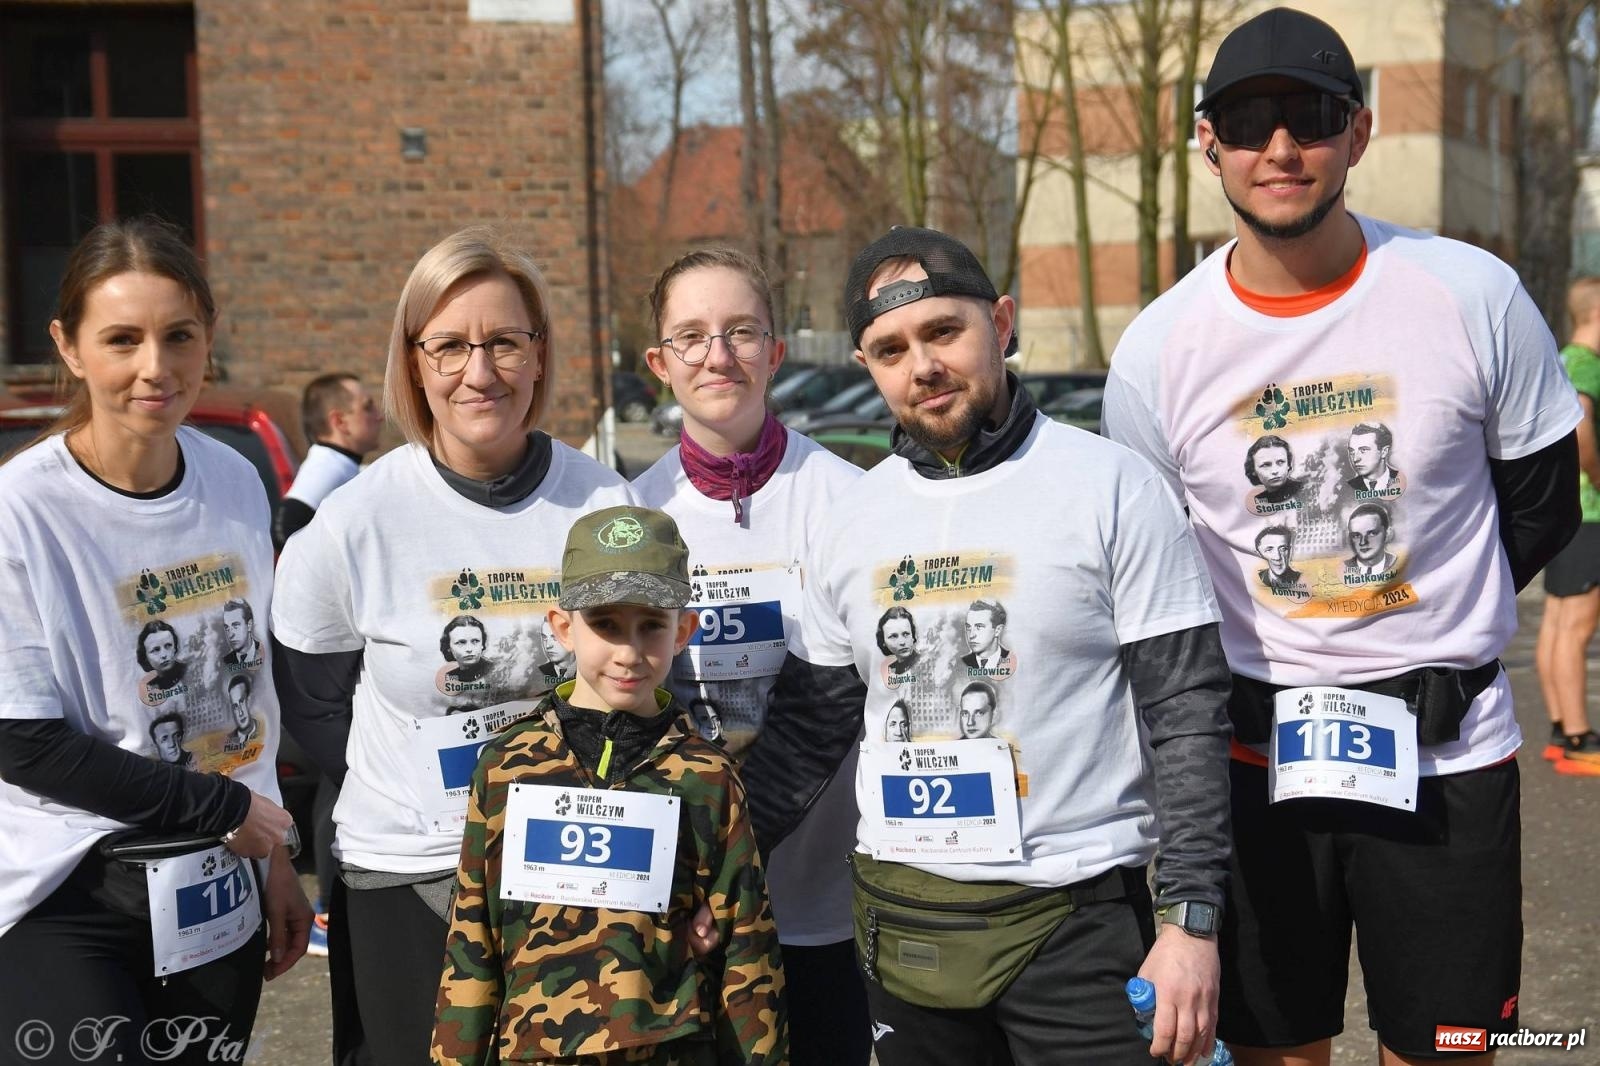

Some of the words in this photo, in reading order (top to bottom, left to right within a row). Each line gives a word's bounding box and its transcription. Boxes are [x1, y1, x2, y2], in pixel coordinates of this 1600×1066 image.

[1293, 382, 1333, 398] TROPEM
[1295, 388, 1373, 417] WILCZYM
[1355, 487, 1401, 500] Rodowicz
[1256, 500, 1303, 514] Stolarska
[924, 556, 960, 570] TROPEM
[165, 563, 200, 581] TROPEM
[488, 572, 525, 583] TROPEM
[924, 565, 993, 590] WILCZYM
[170, 566, 234, 599] WILCZYM
[706, 581, 728, 589] TROPEM
[489, 582, 561, 602] WILCZYM
[707, 586, 750, 600] WILCZYM
[1271, 587, 1310, 600] Kontrym
[1327, 601, 1340, 613] XII
[1343, 598, 1384, 612] EDYCJA
[1383, 588, 1410, 606] 2024
[699, 607, 746, 642] 95
[967, 667, 1011, 677] Rodowicz
[445, 681, 491, 692] Stolarska
[544, 675, 567, 685] Rodo
[148, 684, 188, 702] Stolarska
[483, 710, 506, 722] TROPEM
[1296, 721, 1372, 760] 113
[915, 755, 959, 769] WILCZYM
[1383, 770, 1396, 778] 2024
[445, 790, 461, 798] 1963
[577, 794, 602, 803] TROPEM
[908, 777, 956, 815] 92
[576, 803, 625, 818] WILCZYM
[560, 824, 612, 864] 93
[523, 864, 537, 872] 1963
[636, 873, 650, 881] 2024
[178, 928, 193, 938] 1963
